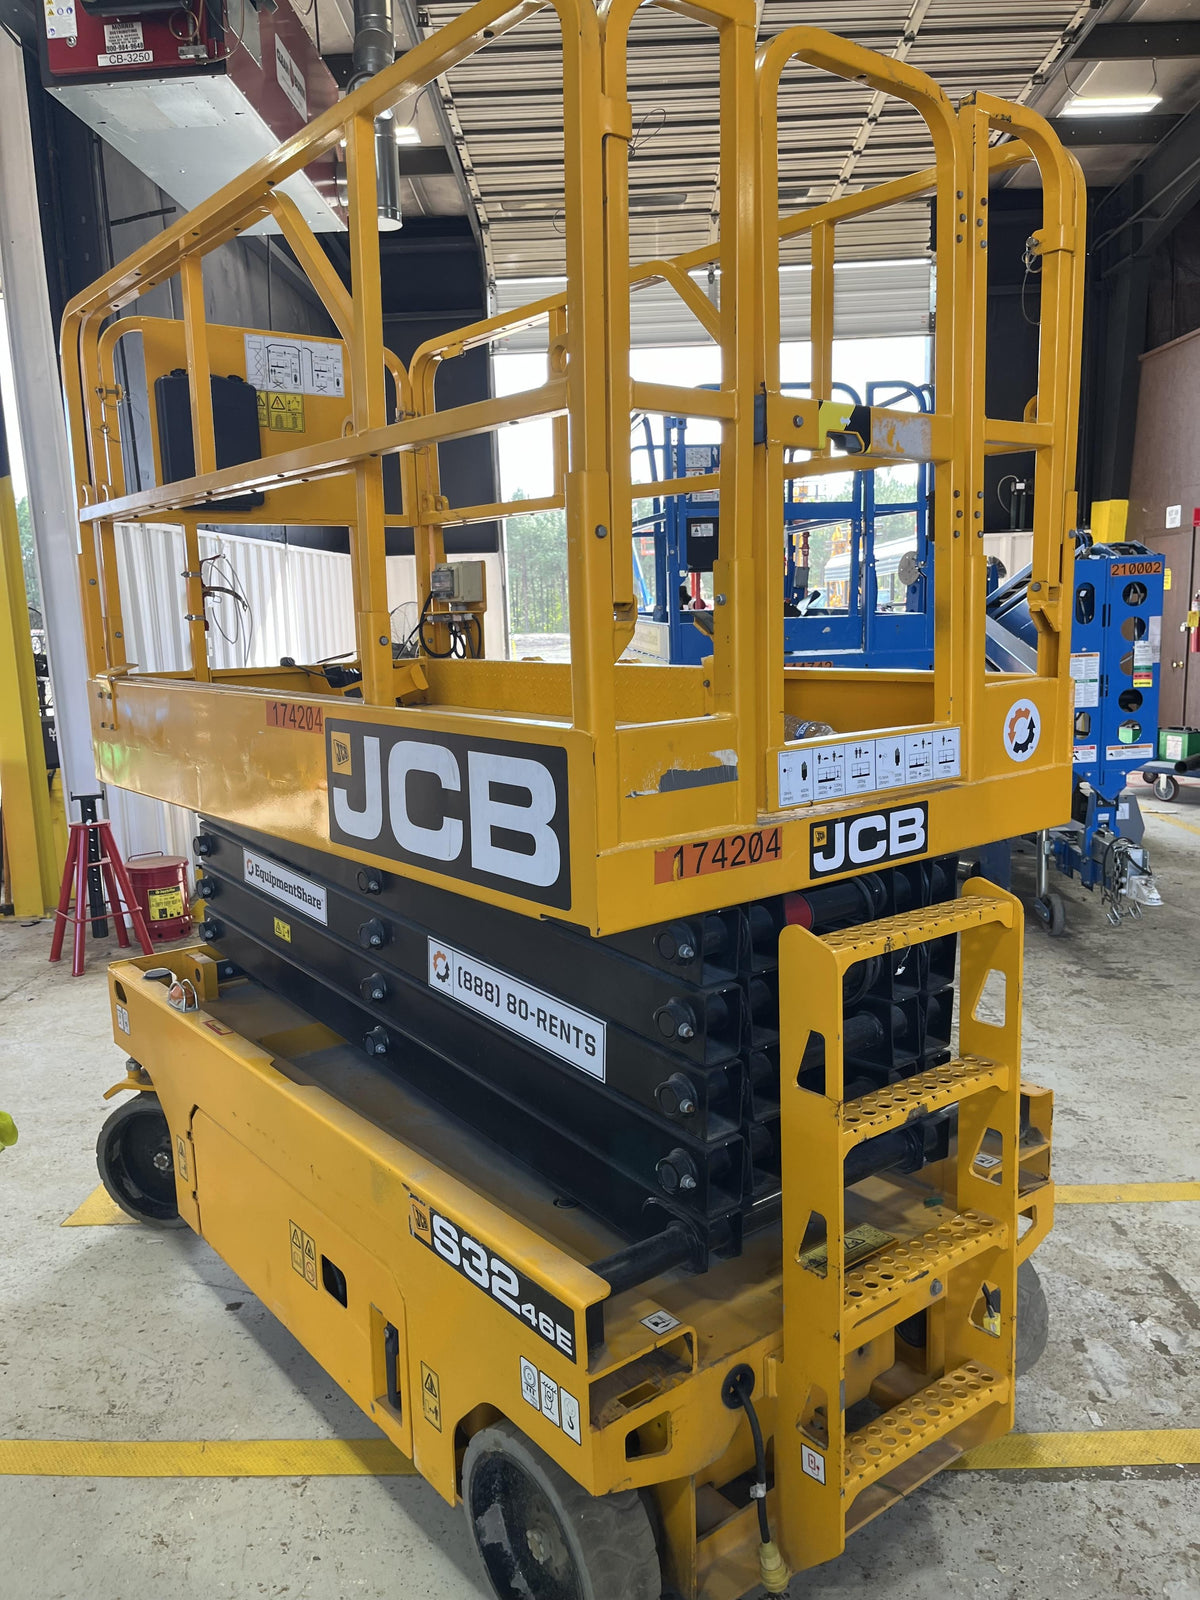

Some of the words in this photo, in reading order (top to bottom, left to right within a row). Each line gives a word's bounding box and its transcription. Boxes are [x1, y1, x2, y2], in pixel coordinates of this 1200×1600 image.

[109, 52, 150, 64] CB-3250
[1111, 562, 1161, 576] 210002
[272, 702, 323, 732] 174204
[333, 736, 561, 888] JCB
[673, 828, 781, 877] 174204
[813, 807, 925, 872] JCB
[254, 863, 322, 910] EquipmentShare
[457, 966, 500, 1008] (888)
[506, 992, 596, 1057] 80-RENTS
